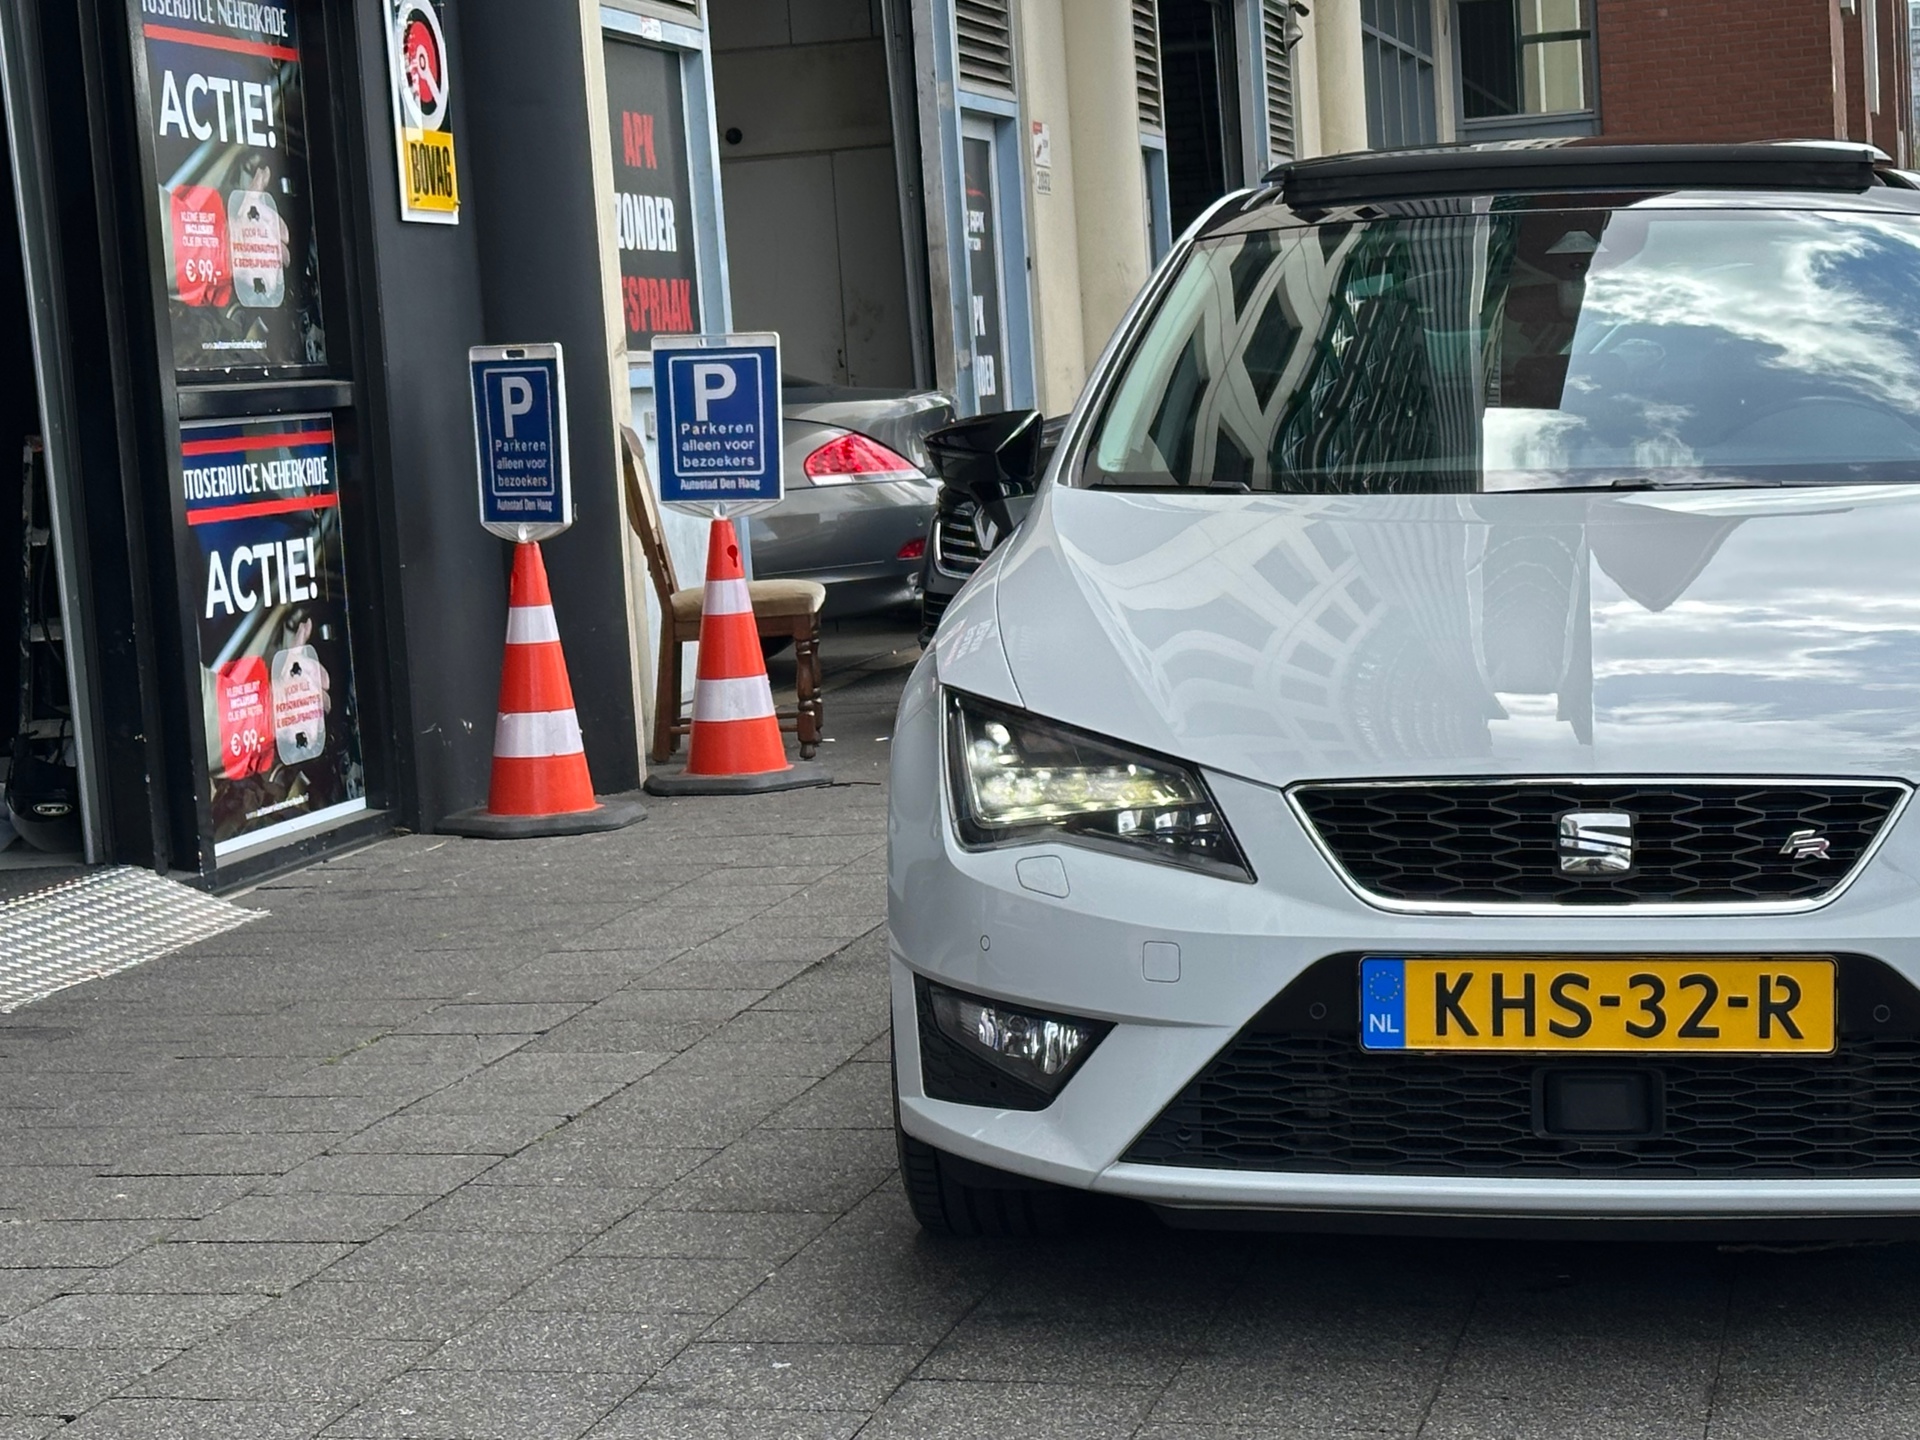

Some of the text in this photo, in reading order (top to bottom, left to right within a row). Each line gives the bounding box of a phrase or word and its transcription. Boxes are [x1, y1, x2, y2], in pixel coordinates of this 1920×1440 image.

[159, 69, 276, 148] ACTIE!
[622, 110, 657, 170] APK
[410, 142, 453, 198] BOVAG
[614, 192, 676, 252] ZONDER
[186, 258, 197, 282] €
[501, 376, 533, 438] P
[693, 363, 737, 422] P
[681, 422, 754, 435] Parkeren
[495, 438, 547, 453] Parkeren
[681, 439, 755, 451] alleen voor
[261, 456, 329, 492] NEHERKADE
[496, 456, 547, 470] alleen voor
[683, 454, 755, 468] bezoekers
[498, 473, 548, 488] bezoekers
[680, 477, 761, 492] Autostad Den Haag
[205, 537, 318, 619] ACTIE!
[1434, 971, 1805, 1040] KHS-32-R
[1369, 1013, 1399, 1033] NL
